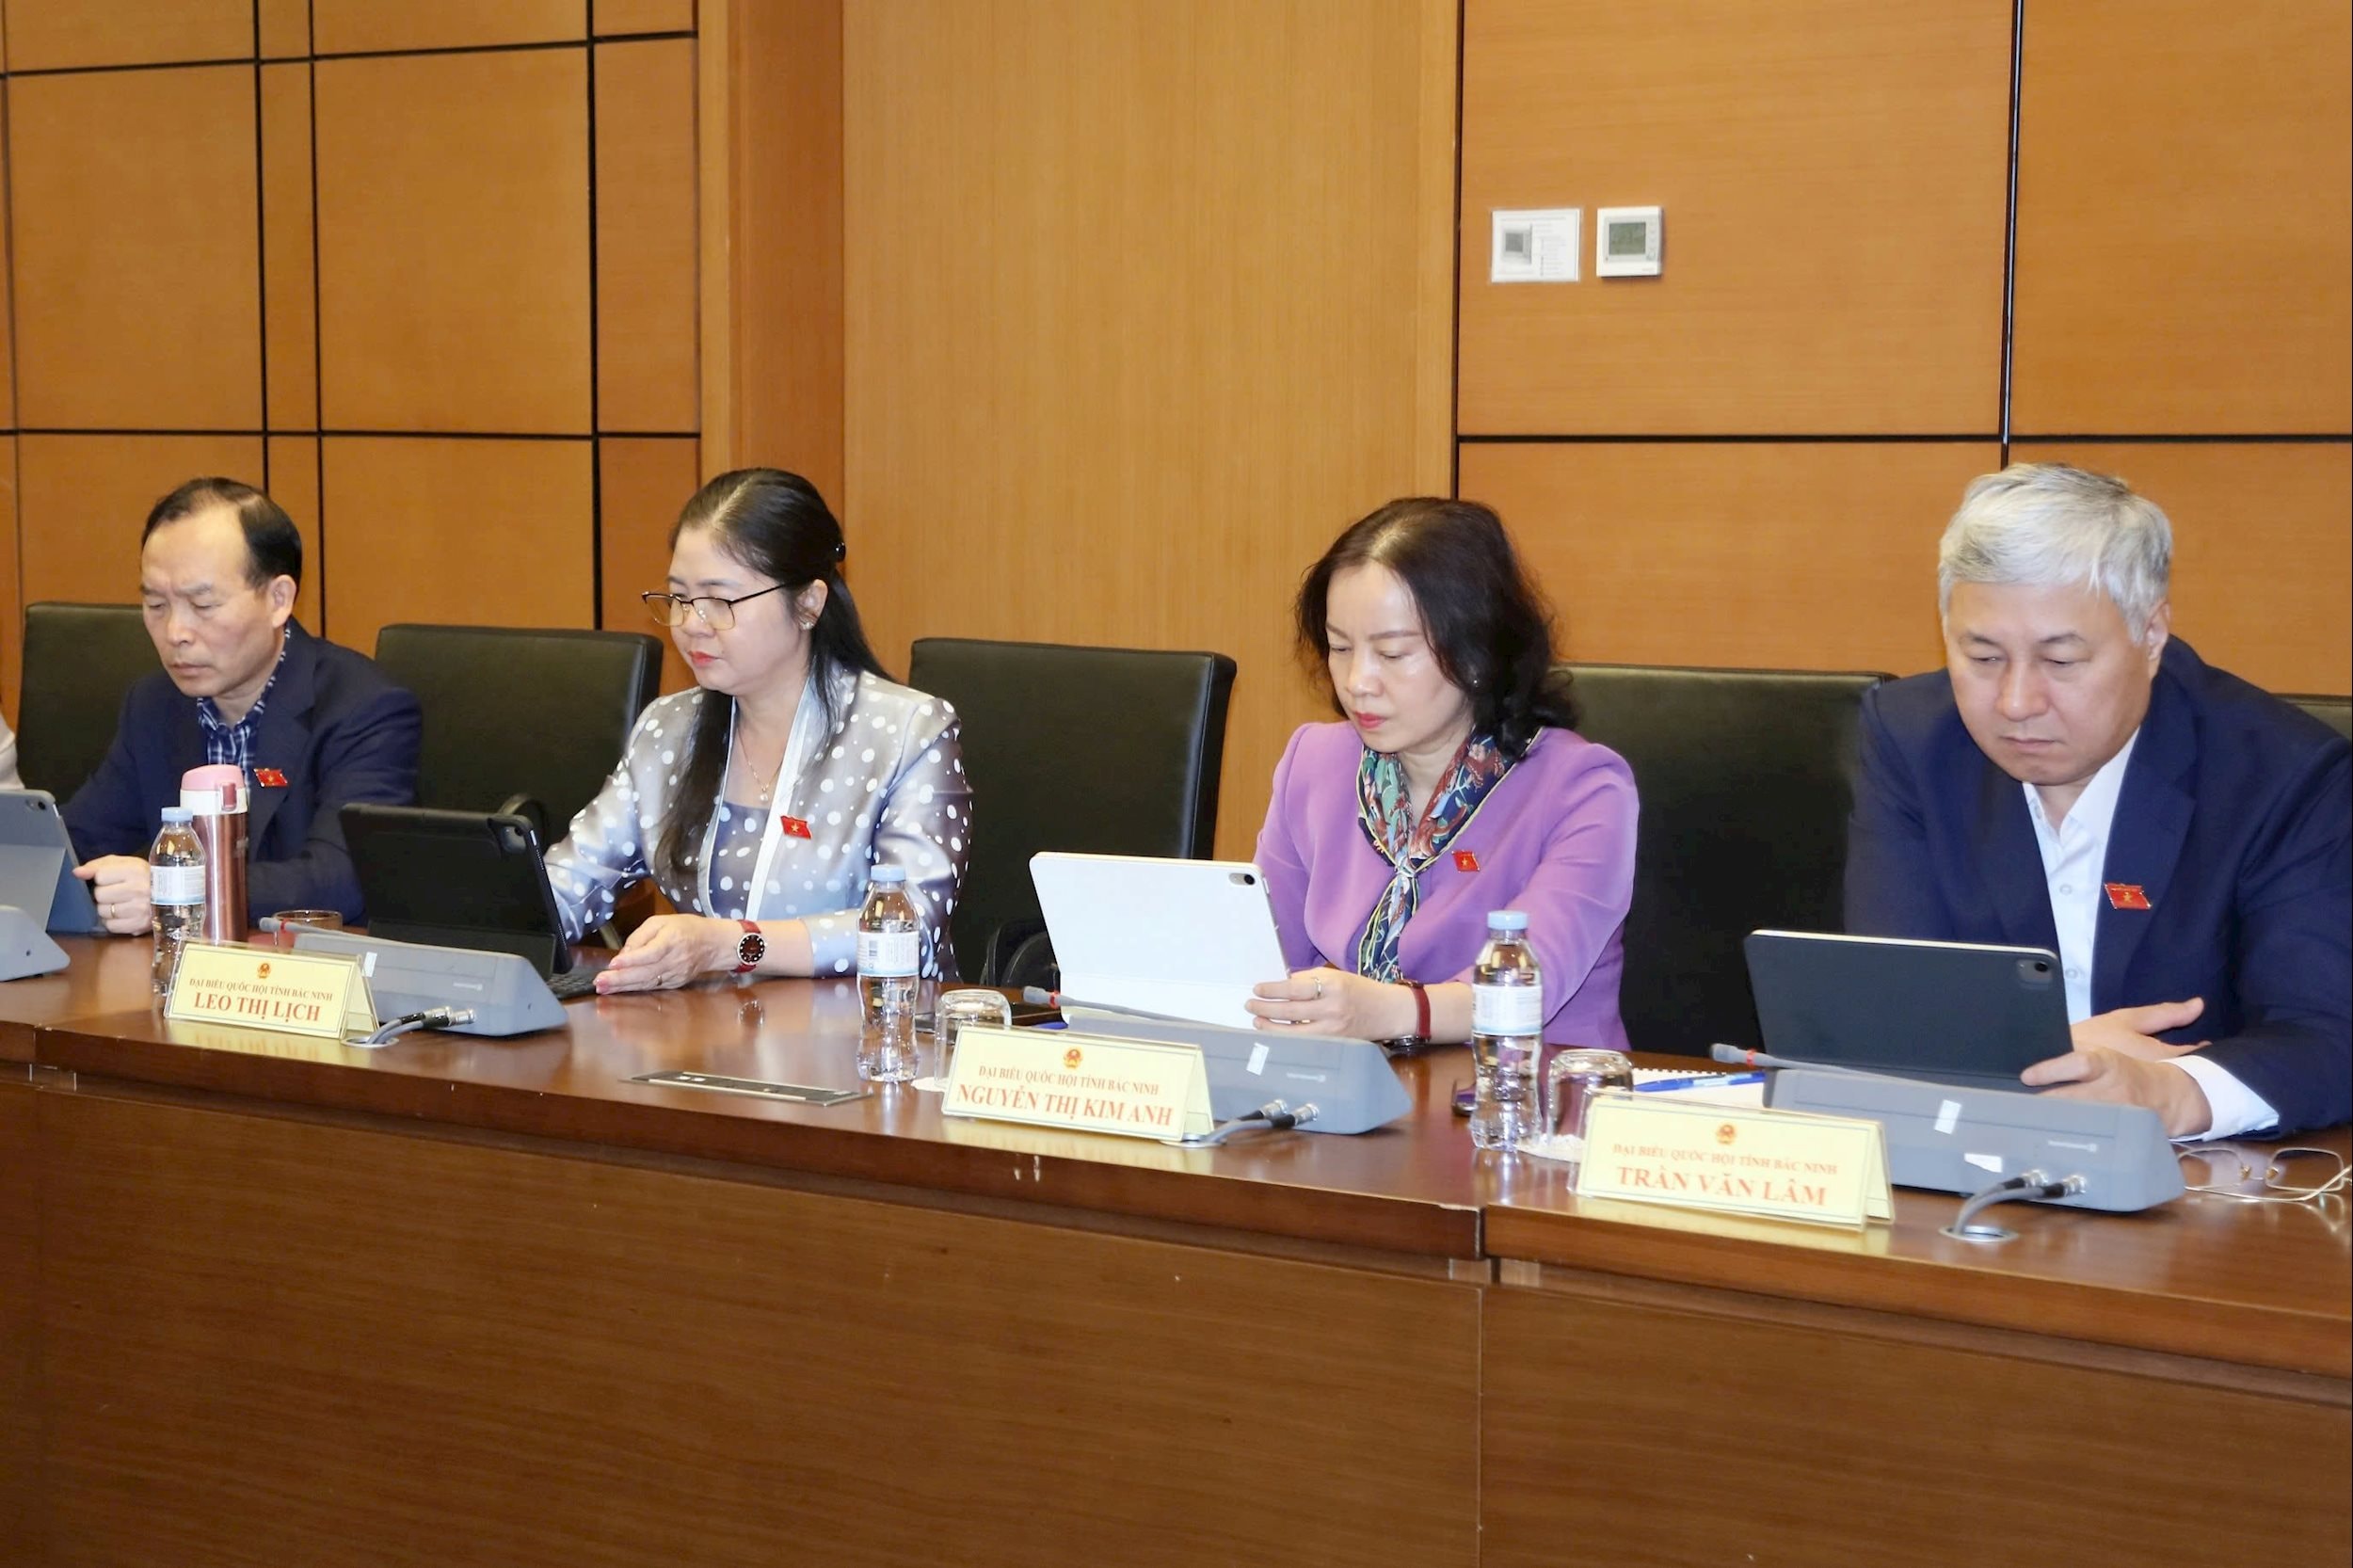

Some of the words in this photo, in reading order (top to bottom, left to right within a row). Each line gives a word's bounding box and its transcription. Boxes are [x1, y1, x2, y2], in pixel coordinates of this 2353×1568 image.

[194, 992, 232, 1011] LEO
[236, 997, 269, 1020] THỊ
[273, 1000, 321, 1022] LỊCH
[312, 991, 333, 1001] NINH
[1131, 1082, 1160, 1096] NINH
[956, 1083, 1039, 1111] NGUYỄN
[1044, 1093, 1080, 1120] THỊ
[1083, 1098, 1126, 1121] KIM
[1127, 1104, 1174, 1126] ANH
[1803, 1161, 1838, 1175] NINH
[1617, 1165, 1689, 1191] TRẦN
[1698, 1173, 1754, 1197] VĂN
[1764, 1178, 1827, 1206] LÂM
